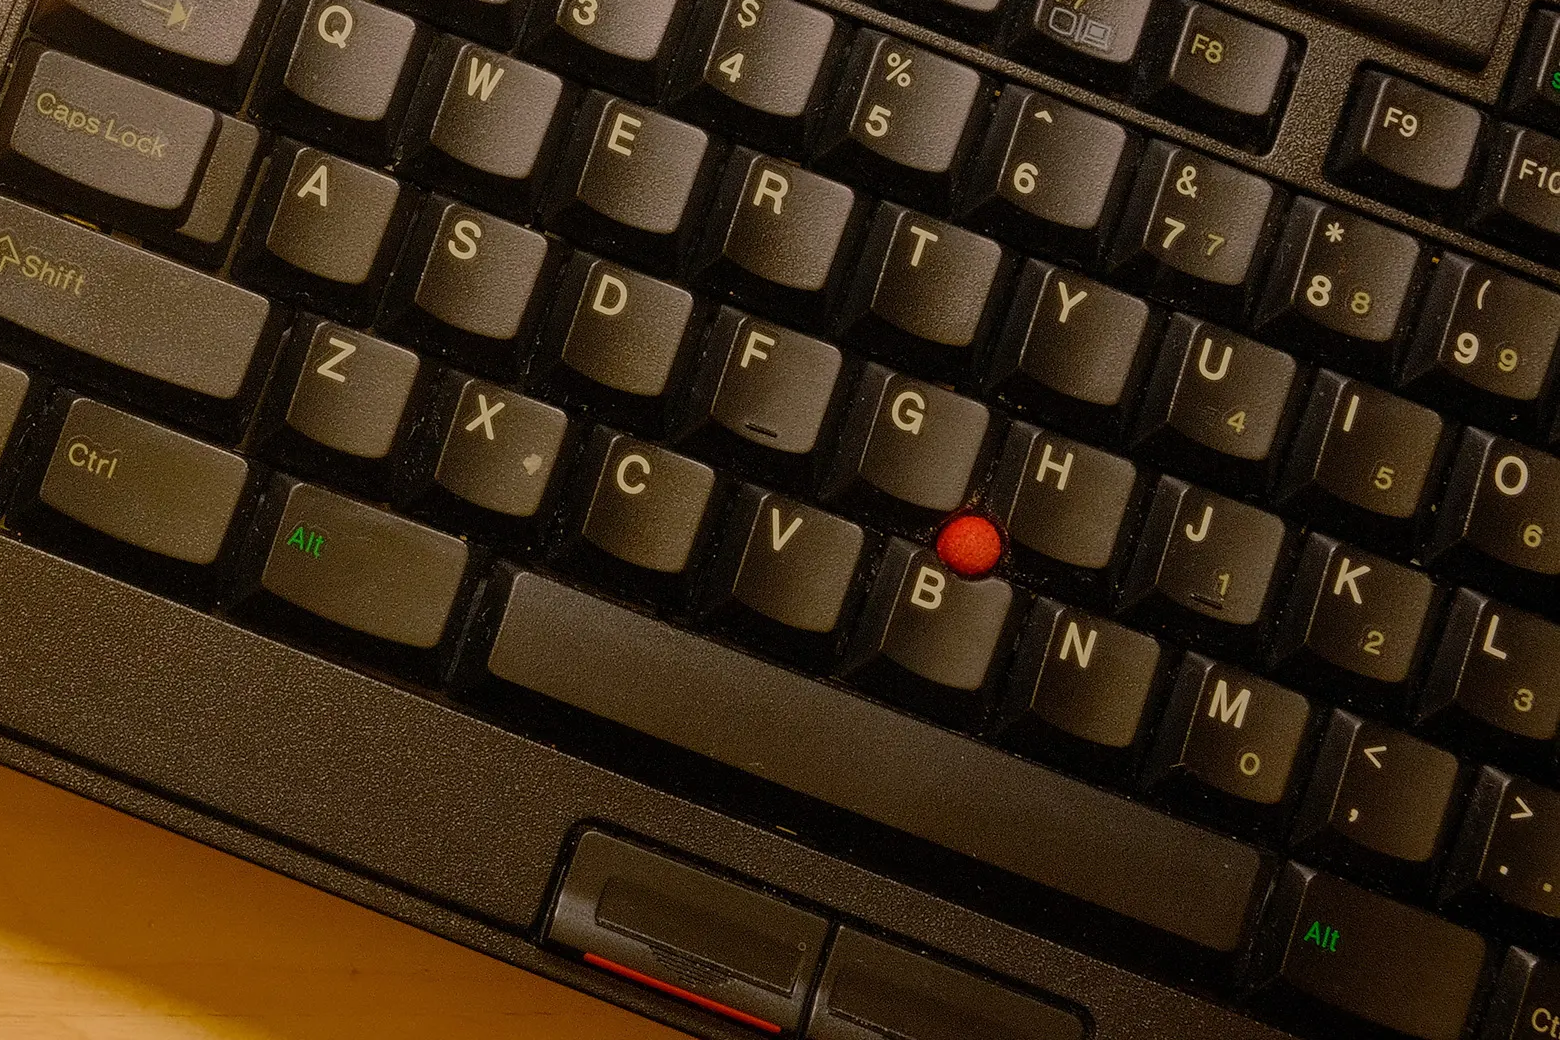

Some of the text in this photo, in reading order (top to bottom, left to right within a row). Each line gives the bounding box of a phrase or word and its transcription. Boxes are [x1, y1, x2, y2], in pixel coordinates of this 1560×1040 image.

[318, 5, 354, 49] Q
[1190, 33, 1225, 62] F8
[469, 57, 504, 101] W
[719, 52, 744, 84] 4
[886, 52, 912, 88] %
[36, 91, 168, 158] Caps Lock
[607, 113, 642, 157] E
[864, 105, 892, 138] 5
[1383, 107, 1418, 137] F9
[297, 164, 328, 207] A
[752, 169, 789, 215] R
[1013, 162, 1039, 194] 6
[1176, 165, 1199, 199] &
[448, 220, 482, 261] S
[909, 226, 939, 267] T
[1161, 217, 1186, 250] 7
[1205, 234, 1226, 257] 7
[20, 253, 85, 297] Shift
[1306, 275, 1332, 307] 8
[591, 274, 628, 316] D
[1057, 282, 1088, 323] Y
[1351, 292, 1370, 314] 8
[1477, 280, 1491, 310] (
[317, 338, 357, 383] Z
[740, 332, 775, 368] F
[1198, 338, 1233, 381] U
[1453, 332, 1479, 364] 9
[1497, 348, 1518, 372] 9
[464, 393, 505, 441] X
[891, 391, 926, 435] G
[1227, 411, 1246, 433] 4
[1343, 395, 1359, 432] I
[67, 442, 118, 480] Ctrl
[616, 453, 651, 495] C
[1036, 444, 1074, 490] H
[1374, 467, 1394, 490] 5
[1495, 455, 1528, 496] O
[286, 525, 325, 559] Alt
[771, 508, 803, 552] V
[1186, 506, 1213, 542] J
[1523, 524, 1543, 547] 6
[910, 566, 946, 610] B
[1218, 573, 1230, 595] 1
[1333, 557, 1371, 604] K
[1058, 622, 1097, 668] N
[1364, 630, 1385, 655] 2
[1483, 614, 1507, 660] L
[1207, 680, 1252, 729] M
[1514, 688, 1534, 712] 3
[1364, 746, 1388, 769] <
[1510, 796, 1533, 819] >
[1303, 921, 1340, 953] Alt
